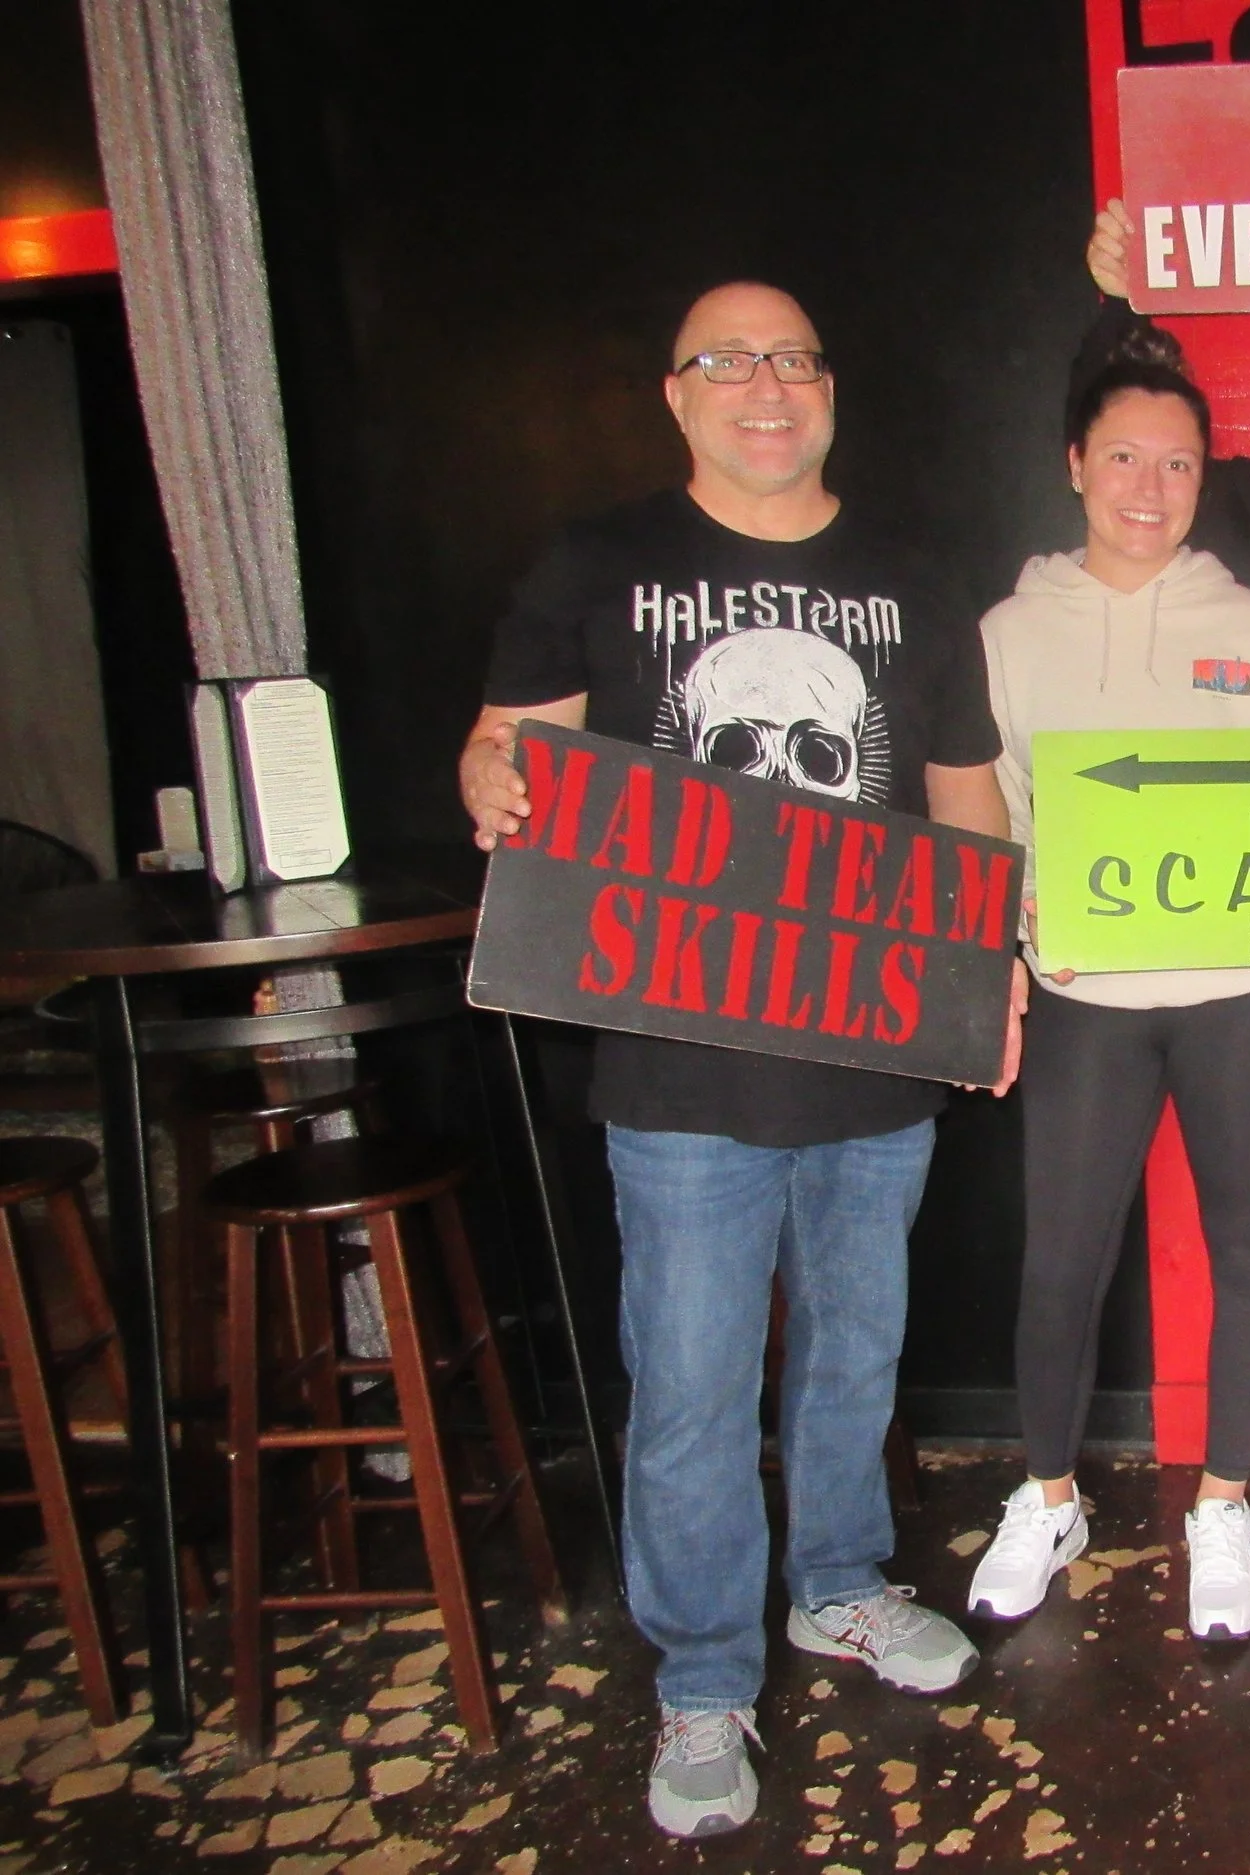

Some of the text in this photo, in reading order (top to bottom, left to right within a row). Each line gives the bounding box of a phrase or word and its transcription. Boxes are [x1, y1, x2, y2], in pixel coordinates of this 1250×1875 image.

[505, 737, 733, 889] MAD
[776, 801, 1013, 951] TEAM
[577, 882, 926, 1046] SKILLS
